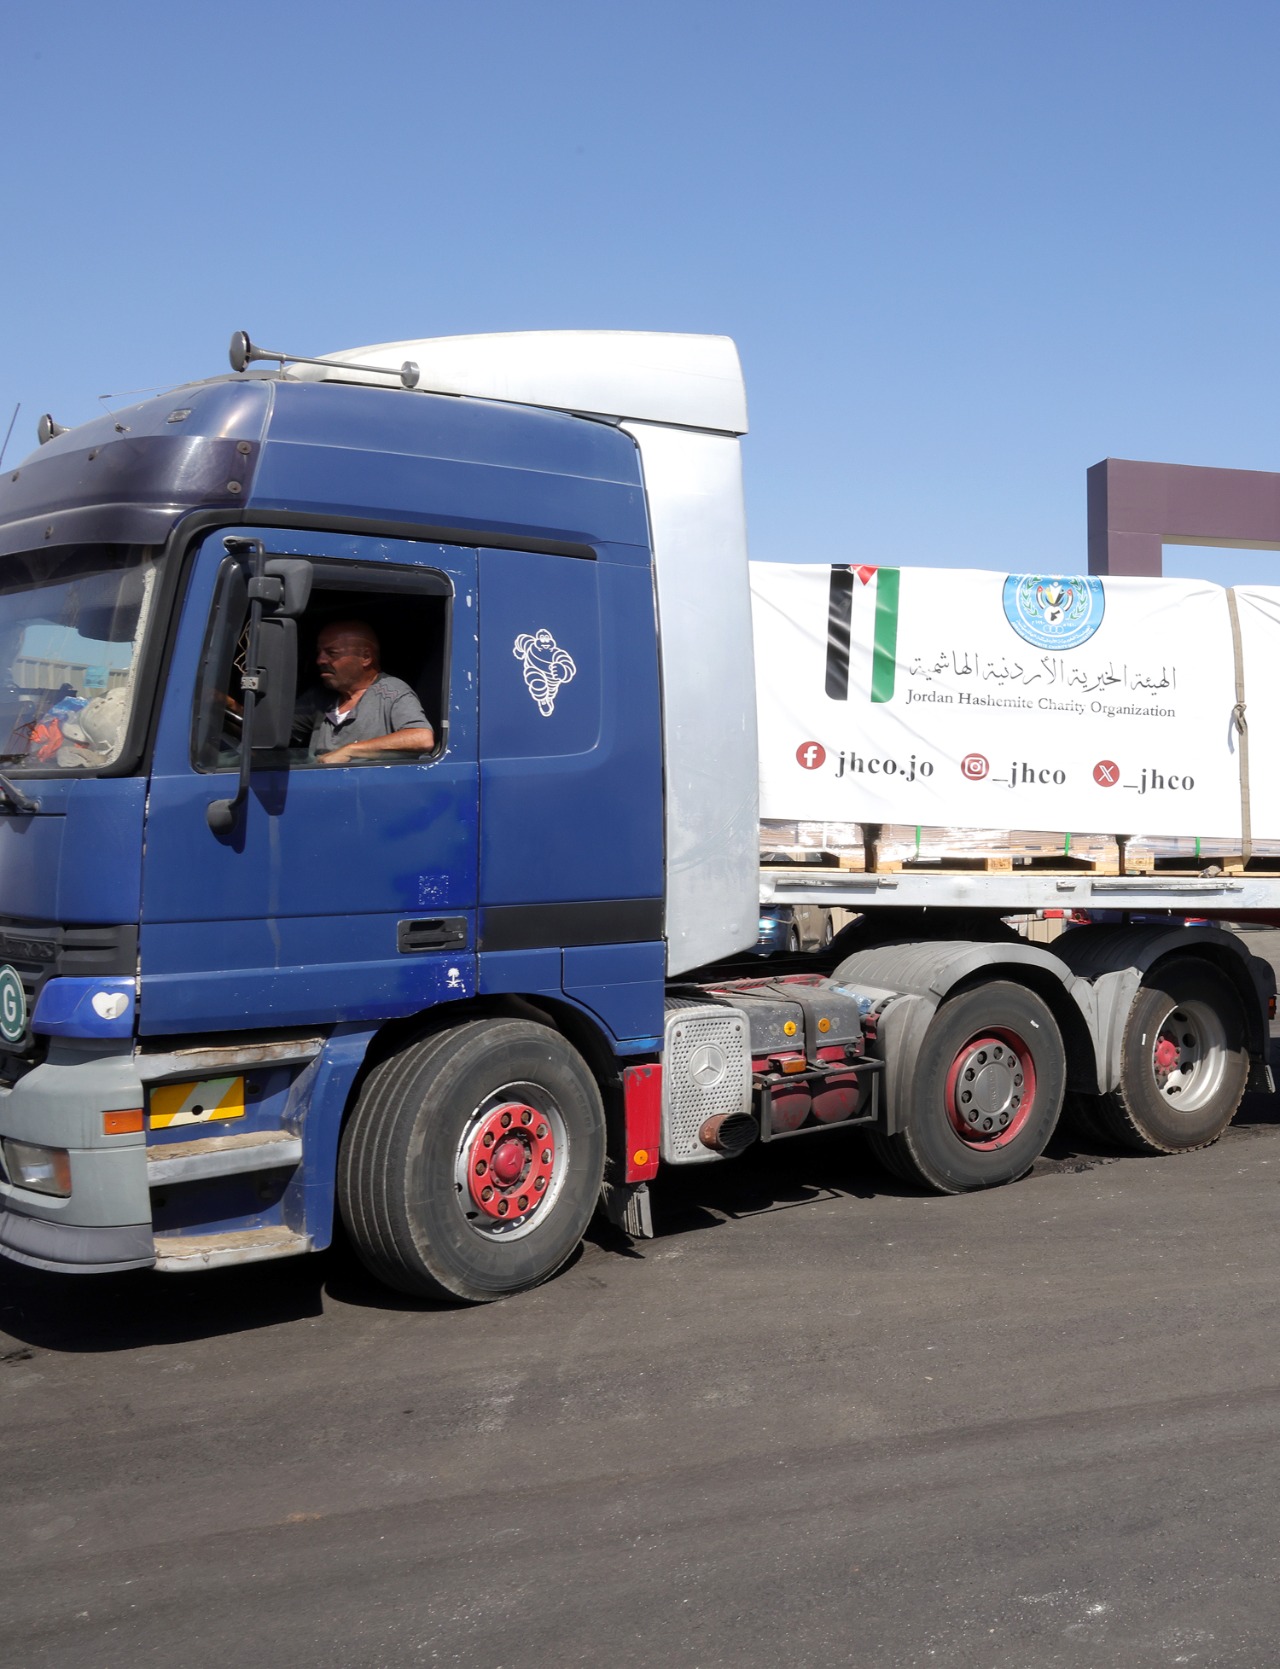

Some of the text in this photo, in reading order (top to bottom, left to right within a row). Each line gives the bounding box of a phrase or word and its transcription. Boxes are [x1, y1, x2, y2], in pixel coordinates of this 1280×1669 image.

[909, 650, 1176, 696] الهيئة الخيرية الأردنية الهاشمية
[905, 689, 1176, 718] Jordan Hashemite Charity Organization
[835, 751, 934, 782] jhco.jo
[992, 761, 1067, 789] _jhco
[1122, 768, 1196, 795] _jhco
[3, 983, 17, 1023] G
